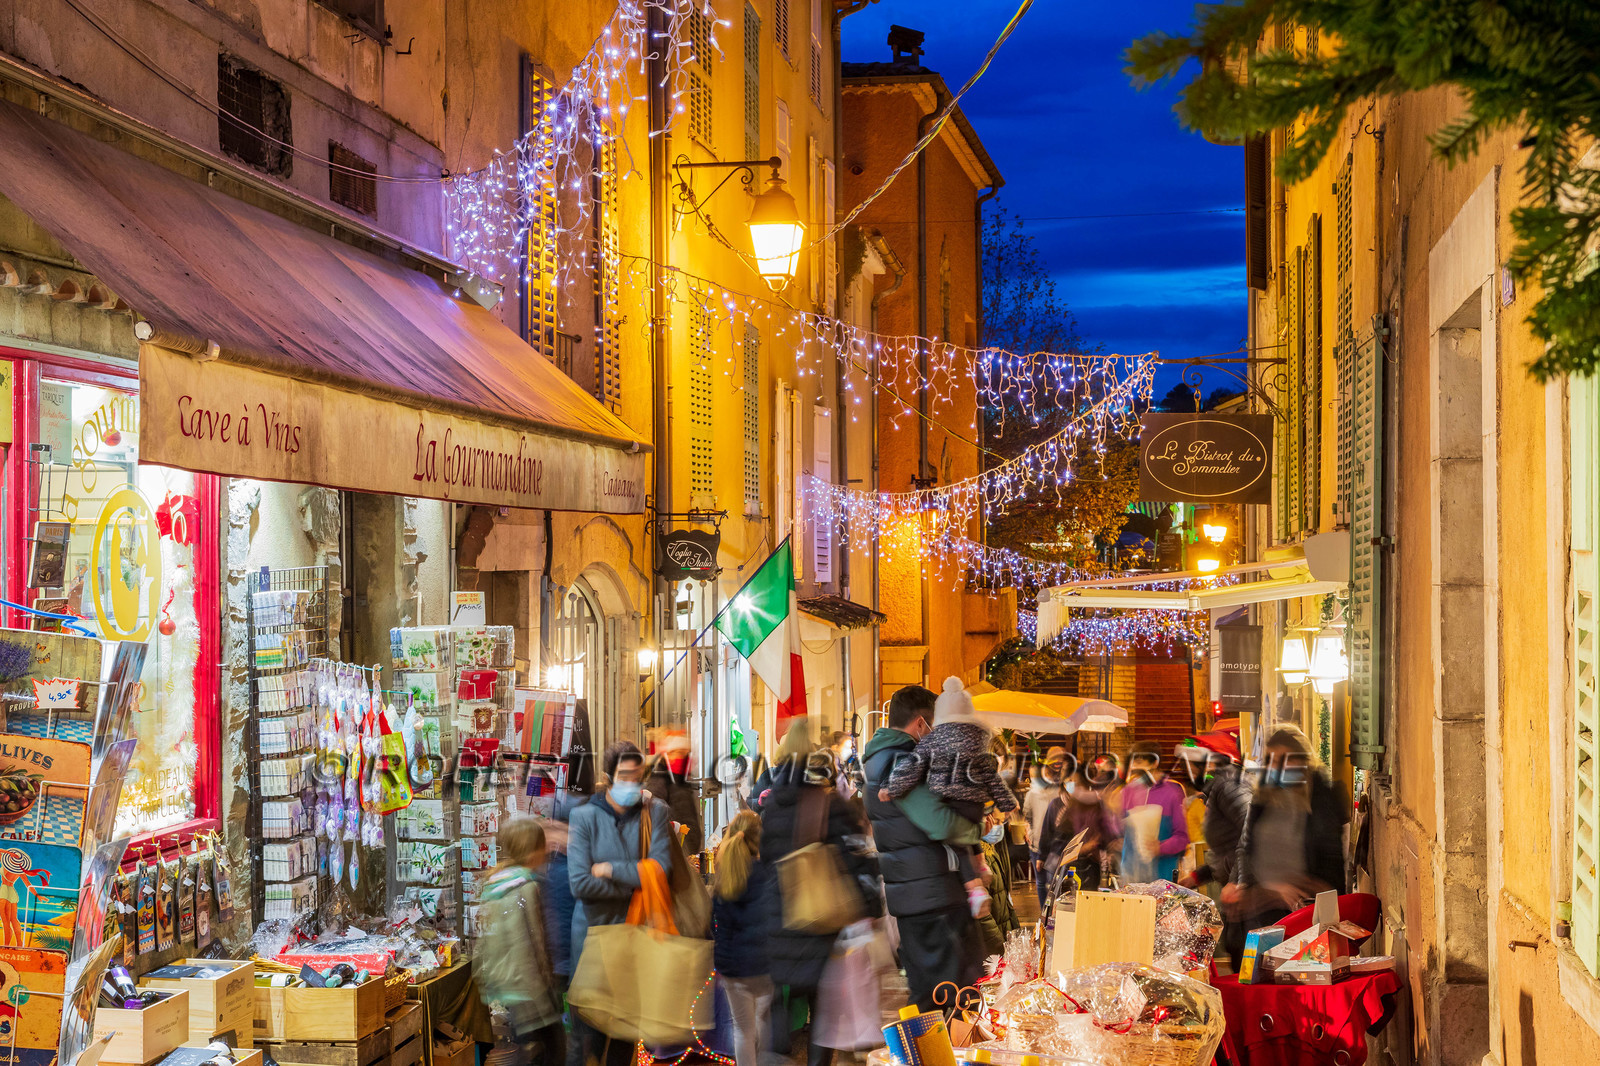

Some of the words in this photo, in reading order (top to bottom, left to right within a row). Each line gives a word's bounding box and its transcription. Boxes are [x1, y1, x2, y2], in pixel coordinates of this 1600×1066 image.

[177, 395, 232, 443] Cave
[236, 403, 252, 446] à
[256, 402, 301, 454] Vins
[413, 422, 439, 482] La
[442, 427, 544, 498] Gourmandine
[1156, 440, 1177, 460] Le
[1187, 440, 1234, 461] Bistrot
[1238, 448, 1254, 462] du
[1173, 455, 1241, 476] Sommelier
[45, 527, 64, 537] PARIS
[667, 542, 693, 561] Voglia
[1219, 662, 1260, 671] emotype
[0, 743, 55, 770] LIVES
